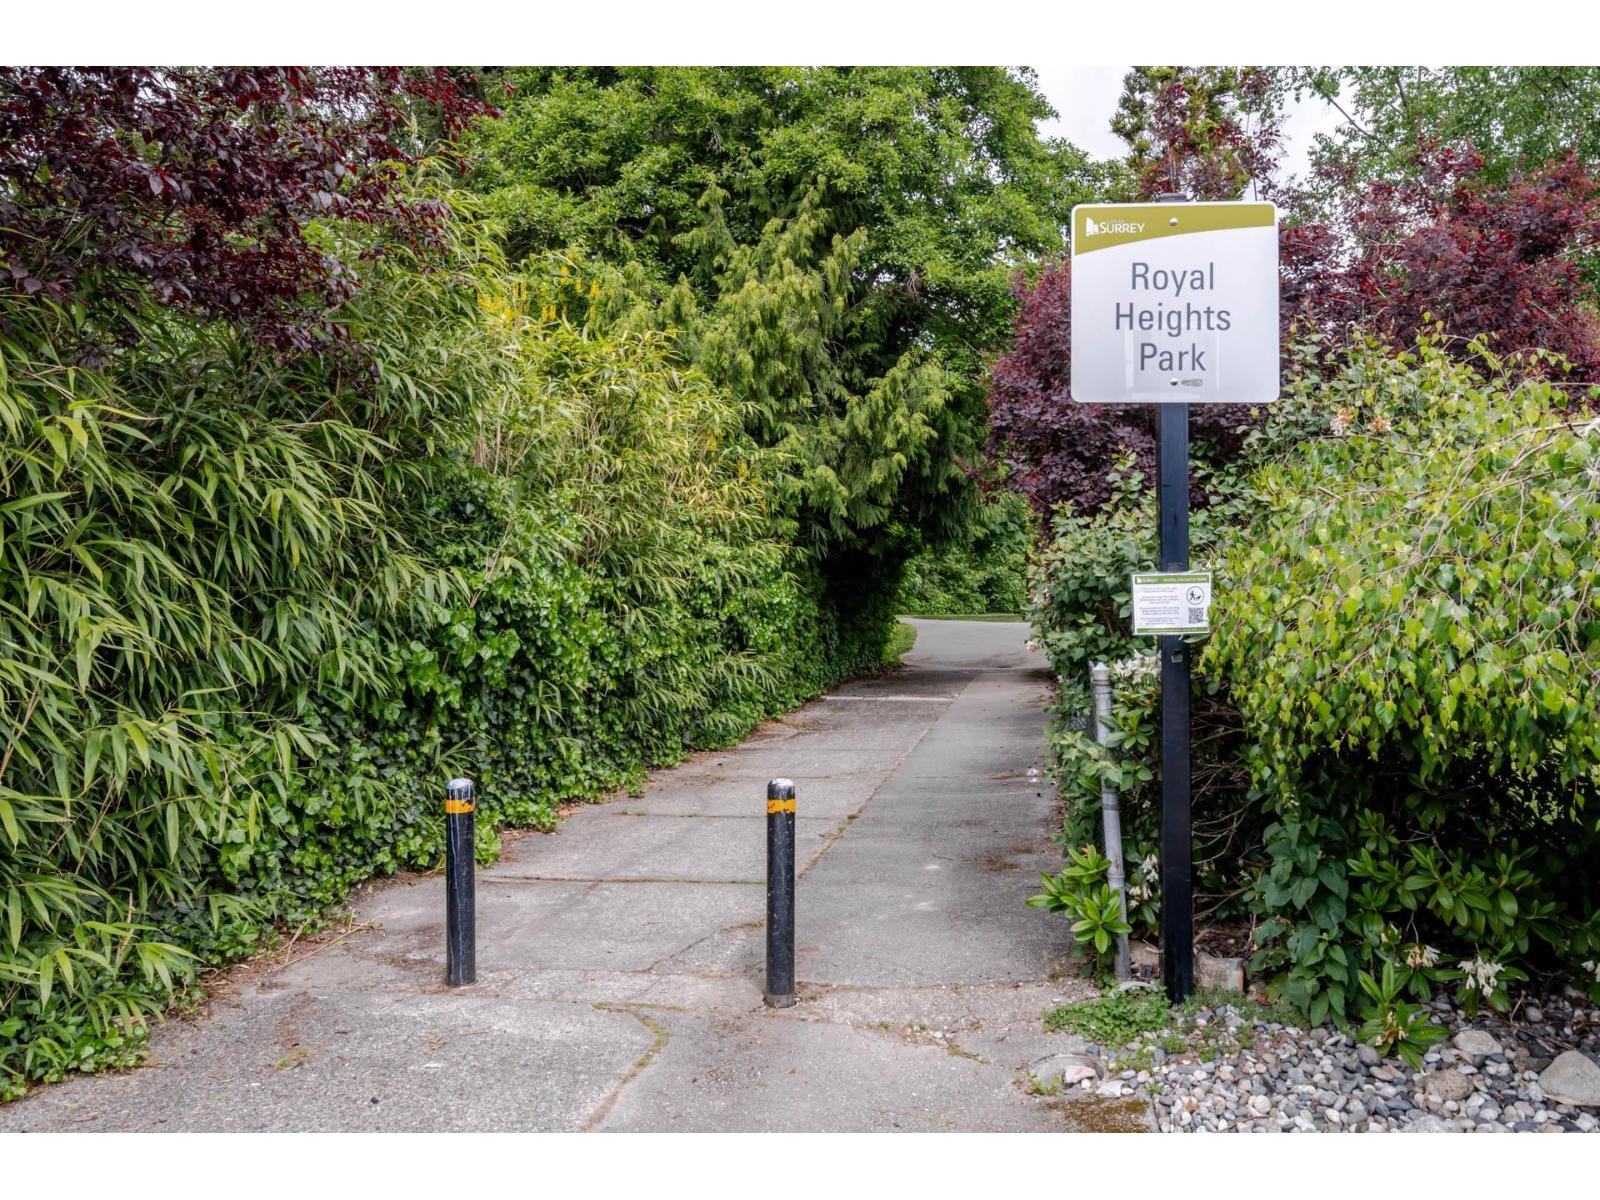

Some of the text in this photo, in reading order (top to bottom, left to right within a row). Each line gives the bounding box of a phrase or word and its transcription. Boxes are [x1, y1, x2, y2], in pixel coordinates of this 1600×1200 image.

[1099, 222, 1145, 234] SURREY
[1131, 262, 1214, 297] Royal
[1115, 302, 1231, 338] Heights
[1140, 342, 1207, 372] Park
